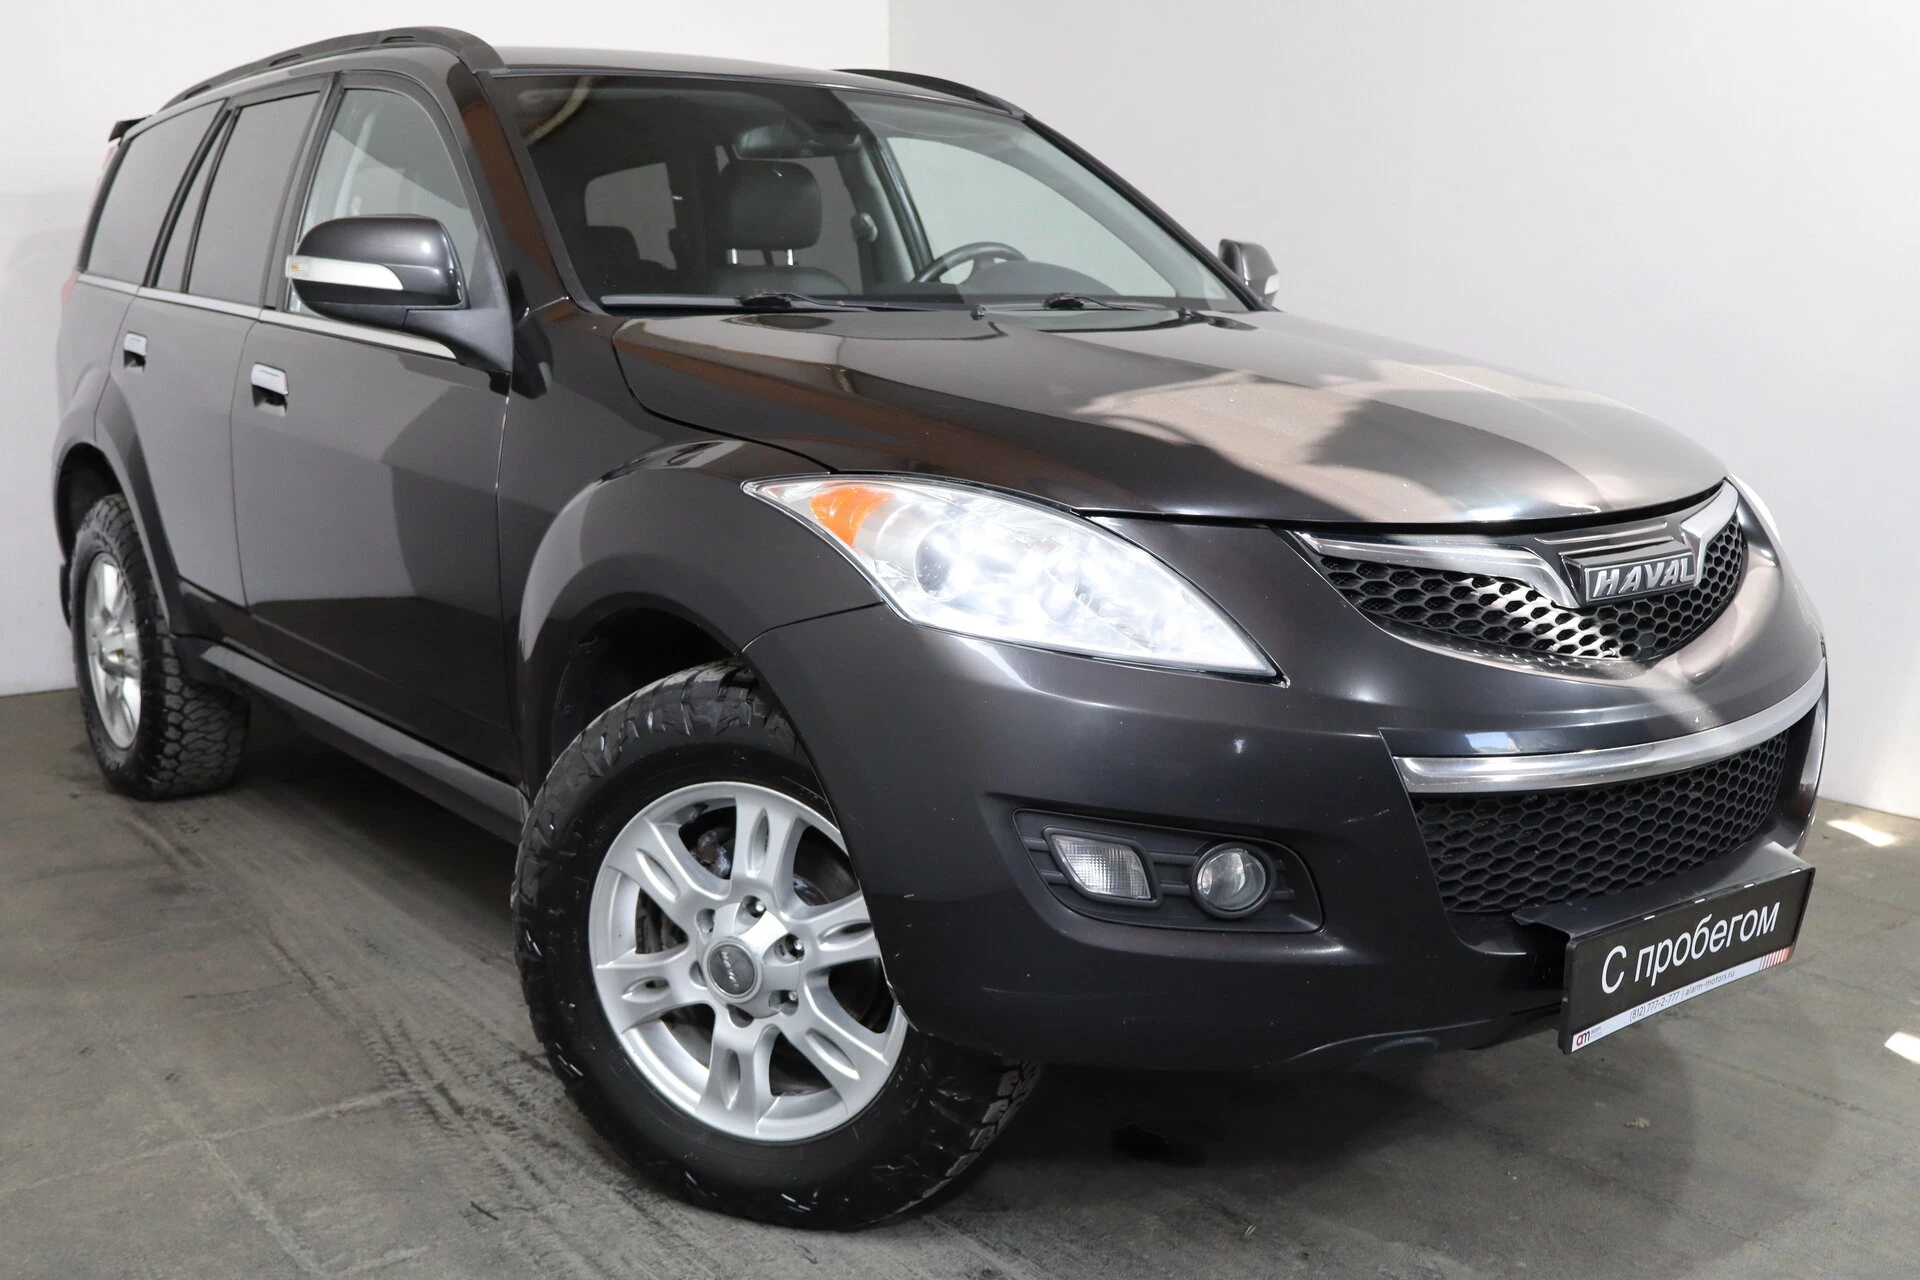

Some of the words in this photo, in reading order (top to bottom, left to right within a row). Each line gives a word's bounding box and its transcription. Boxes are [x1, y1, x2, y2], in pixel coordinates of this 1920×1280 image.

[1593, 557, 1695, 598] HAVAL
[1601, 944, 1628, 995] С
[1634, 901, 1780, 987] пробегом
[1685, 970, 1735, 996] alarm-motors.ru
